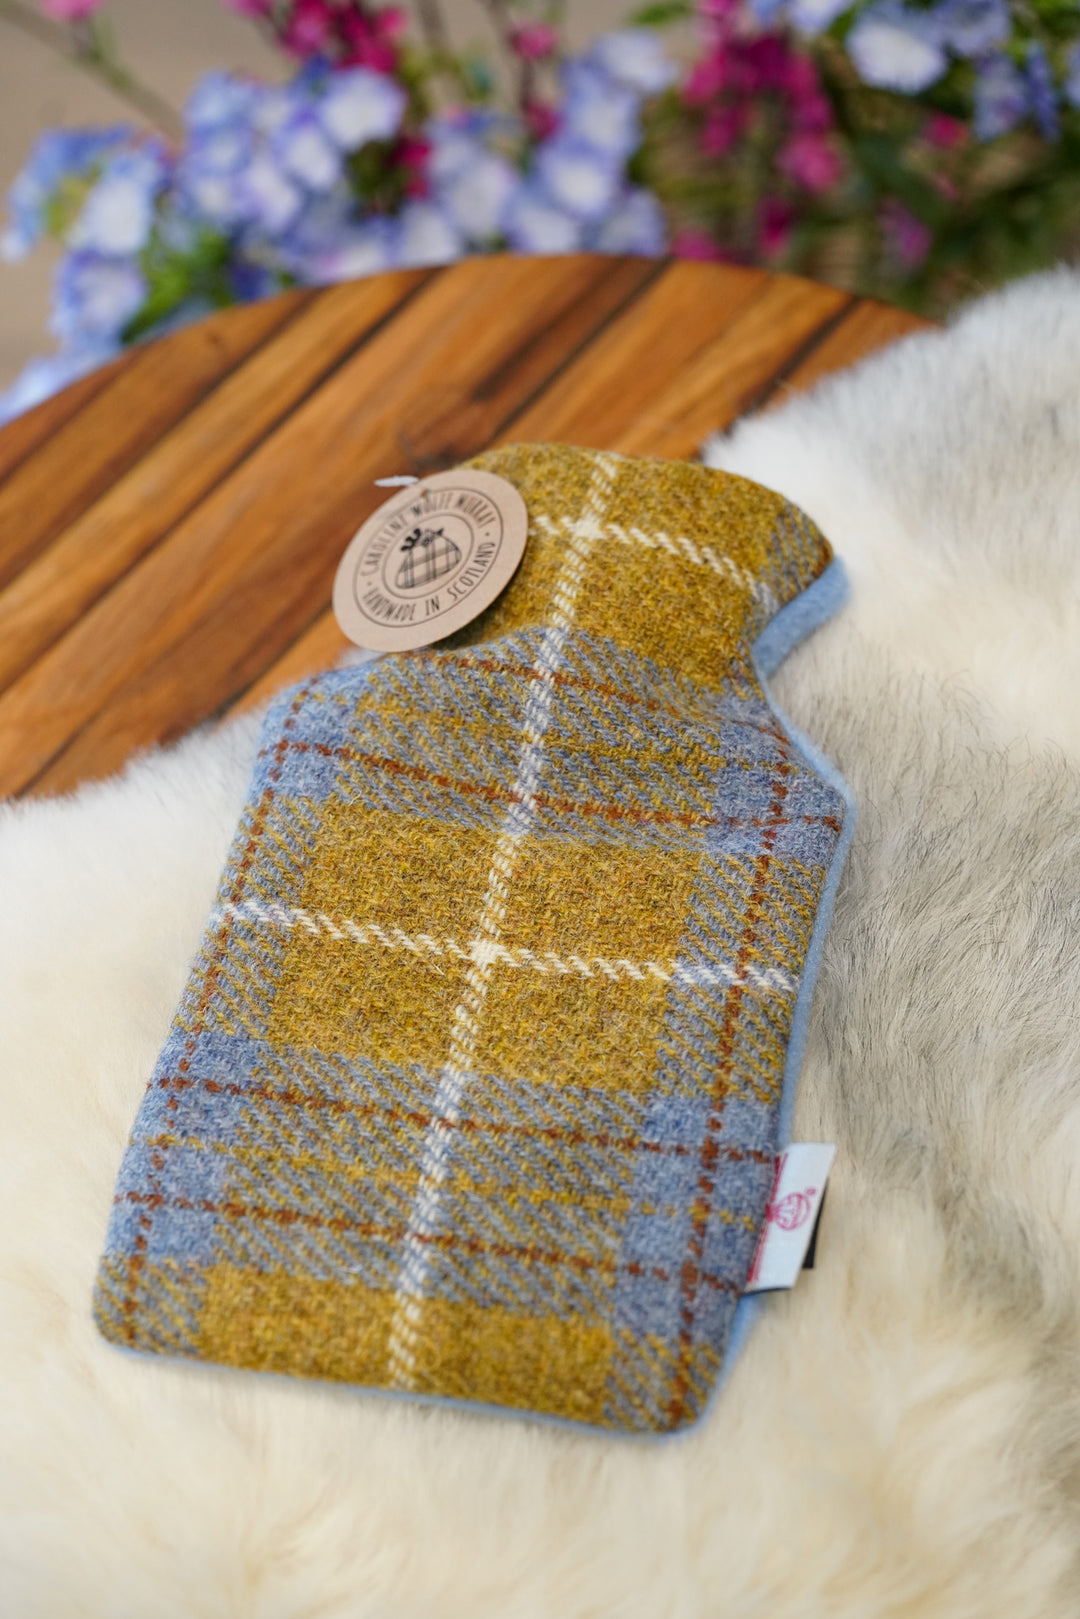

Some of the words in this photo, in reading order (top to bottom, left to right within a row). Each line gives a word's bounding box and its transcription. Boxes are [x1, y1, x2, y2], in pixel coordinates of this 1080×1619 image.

[361, 514, 407, 577] CAROLINE
[456, 494, 496, 529] MURRAY
[362, 587, 416, 622] HANDMADE
[425, 595, 440, 616] IN
[447, 541, 496, 600] SCOTLAND
